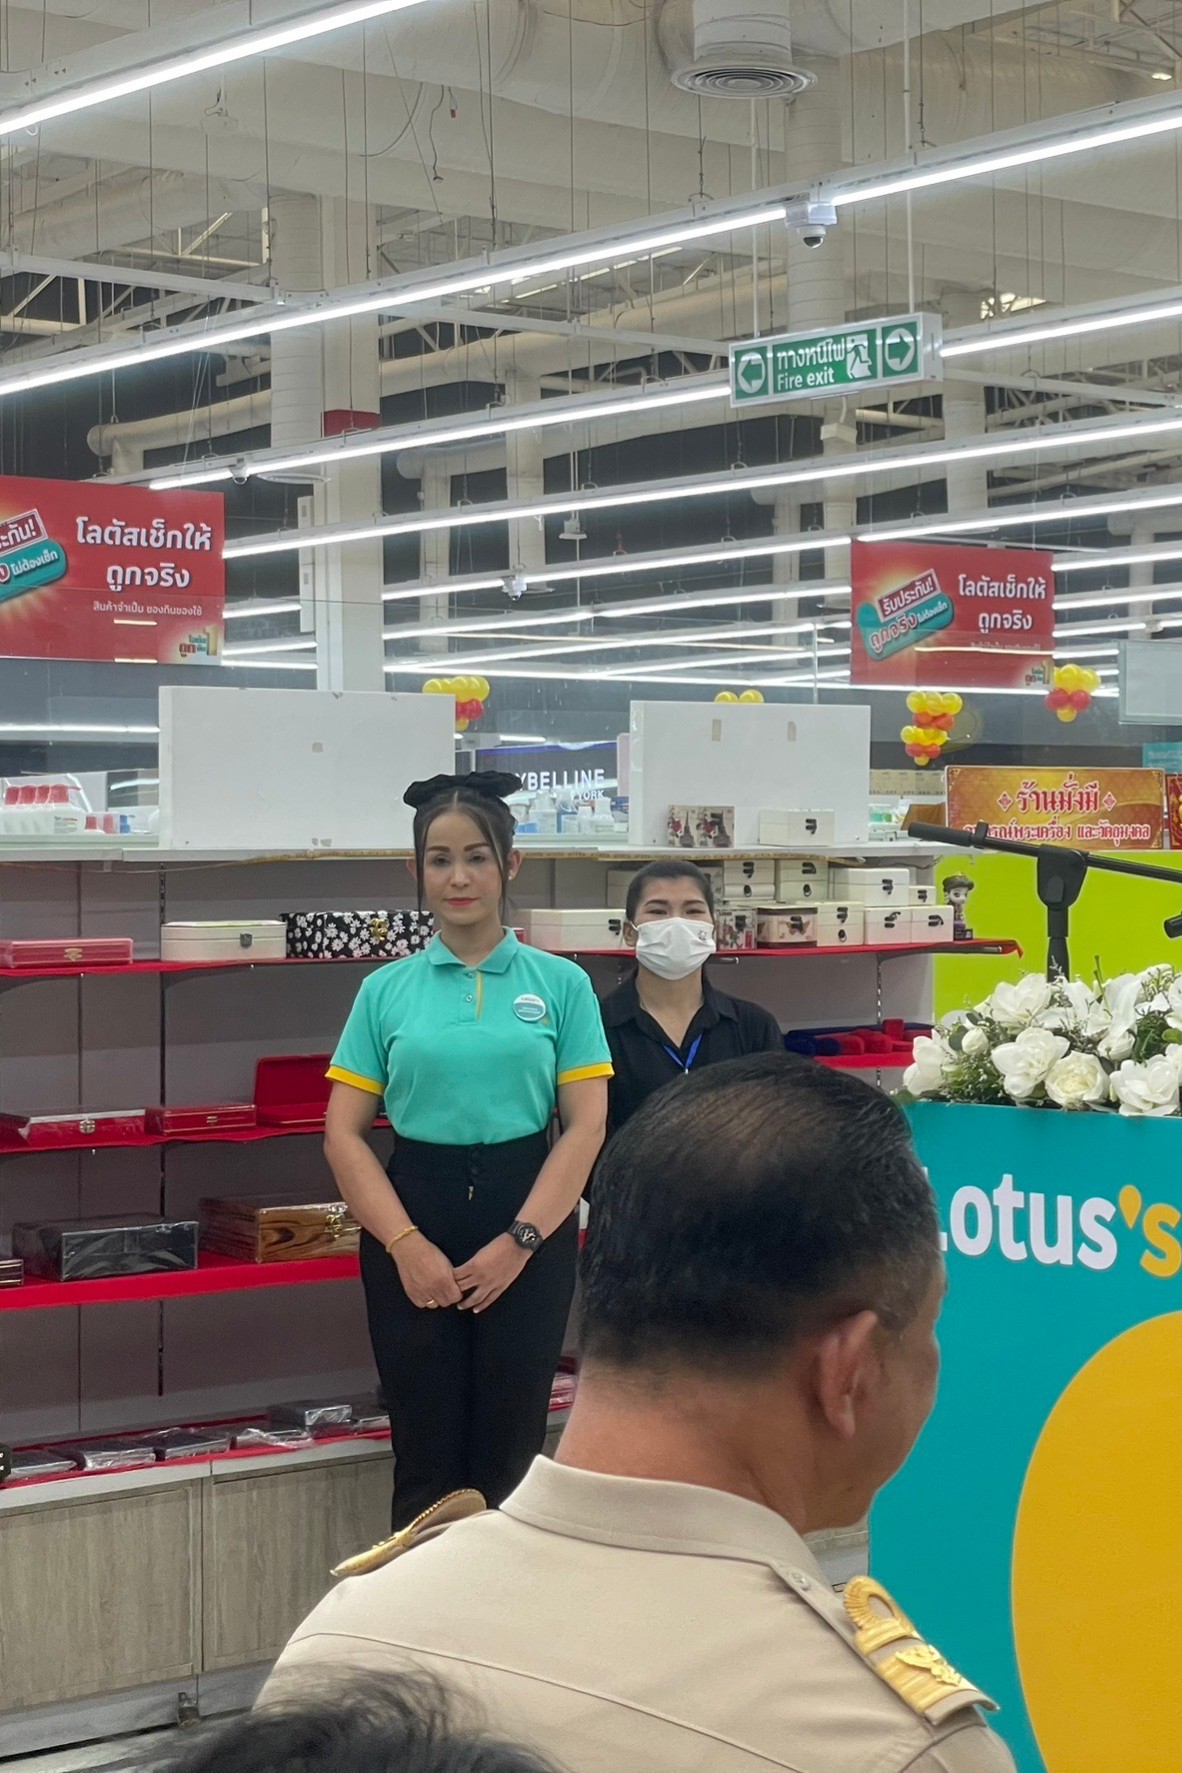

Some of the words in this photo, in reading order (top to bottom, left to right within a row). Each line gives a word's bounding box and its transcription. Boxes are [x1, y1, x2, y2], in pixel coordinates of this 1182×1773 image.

[777, 372, 803, 391] Fire
[806, 366, 835, 386] exit
[76, 516, 212, 551] โลตัสเช็กให้
[106, 562, 191, 592] ถูกจริง
[958, 574, 1047, 600] โลตัสเช็กให้
[883, 576, 934, 615] รับประกัน!
[978, 609, 1033, 634] ถูกจริง
[928, 1173, 1182, 1278] otus's
